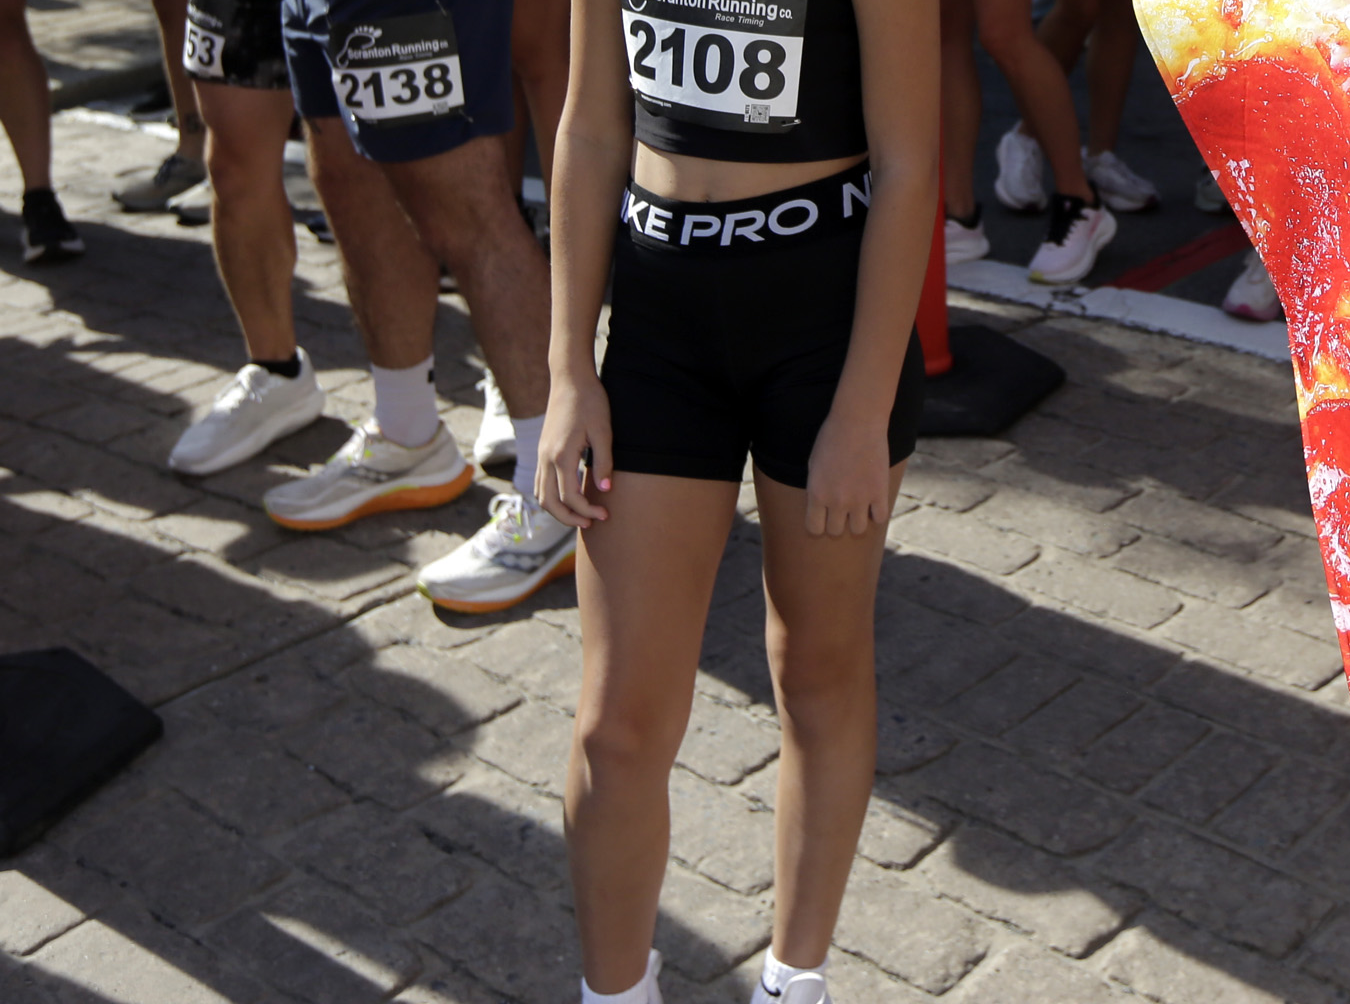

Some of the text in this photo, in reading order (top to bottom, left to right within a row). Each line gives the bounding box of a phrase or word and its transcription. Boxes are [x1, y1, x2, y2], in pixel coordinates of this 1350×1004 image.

[714, 13, 765, 28] Race Timing
[347, 46, 391, 60] Scranton
[391, 39, 440, 56] Running
[629, 19, 787, 101] 2108
[339, 63, 454, 110] 2138
[620, 187, 673, 242] IKE
[680, 199, 819, 246] PRO
